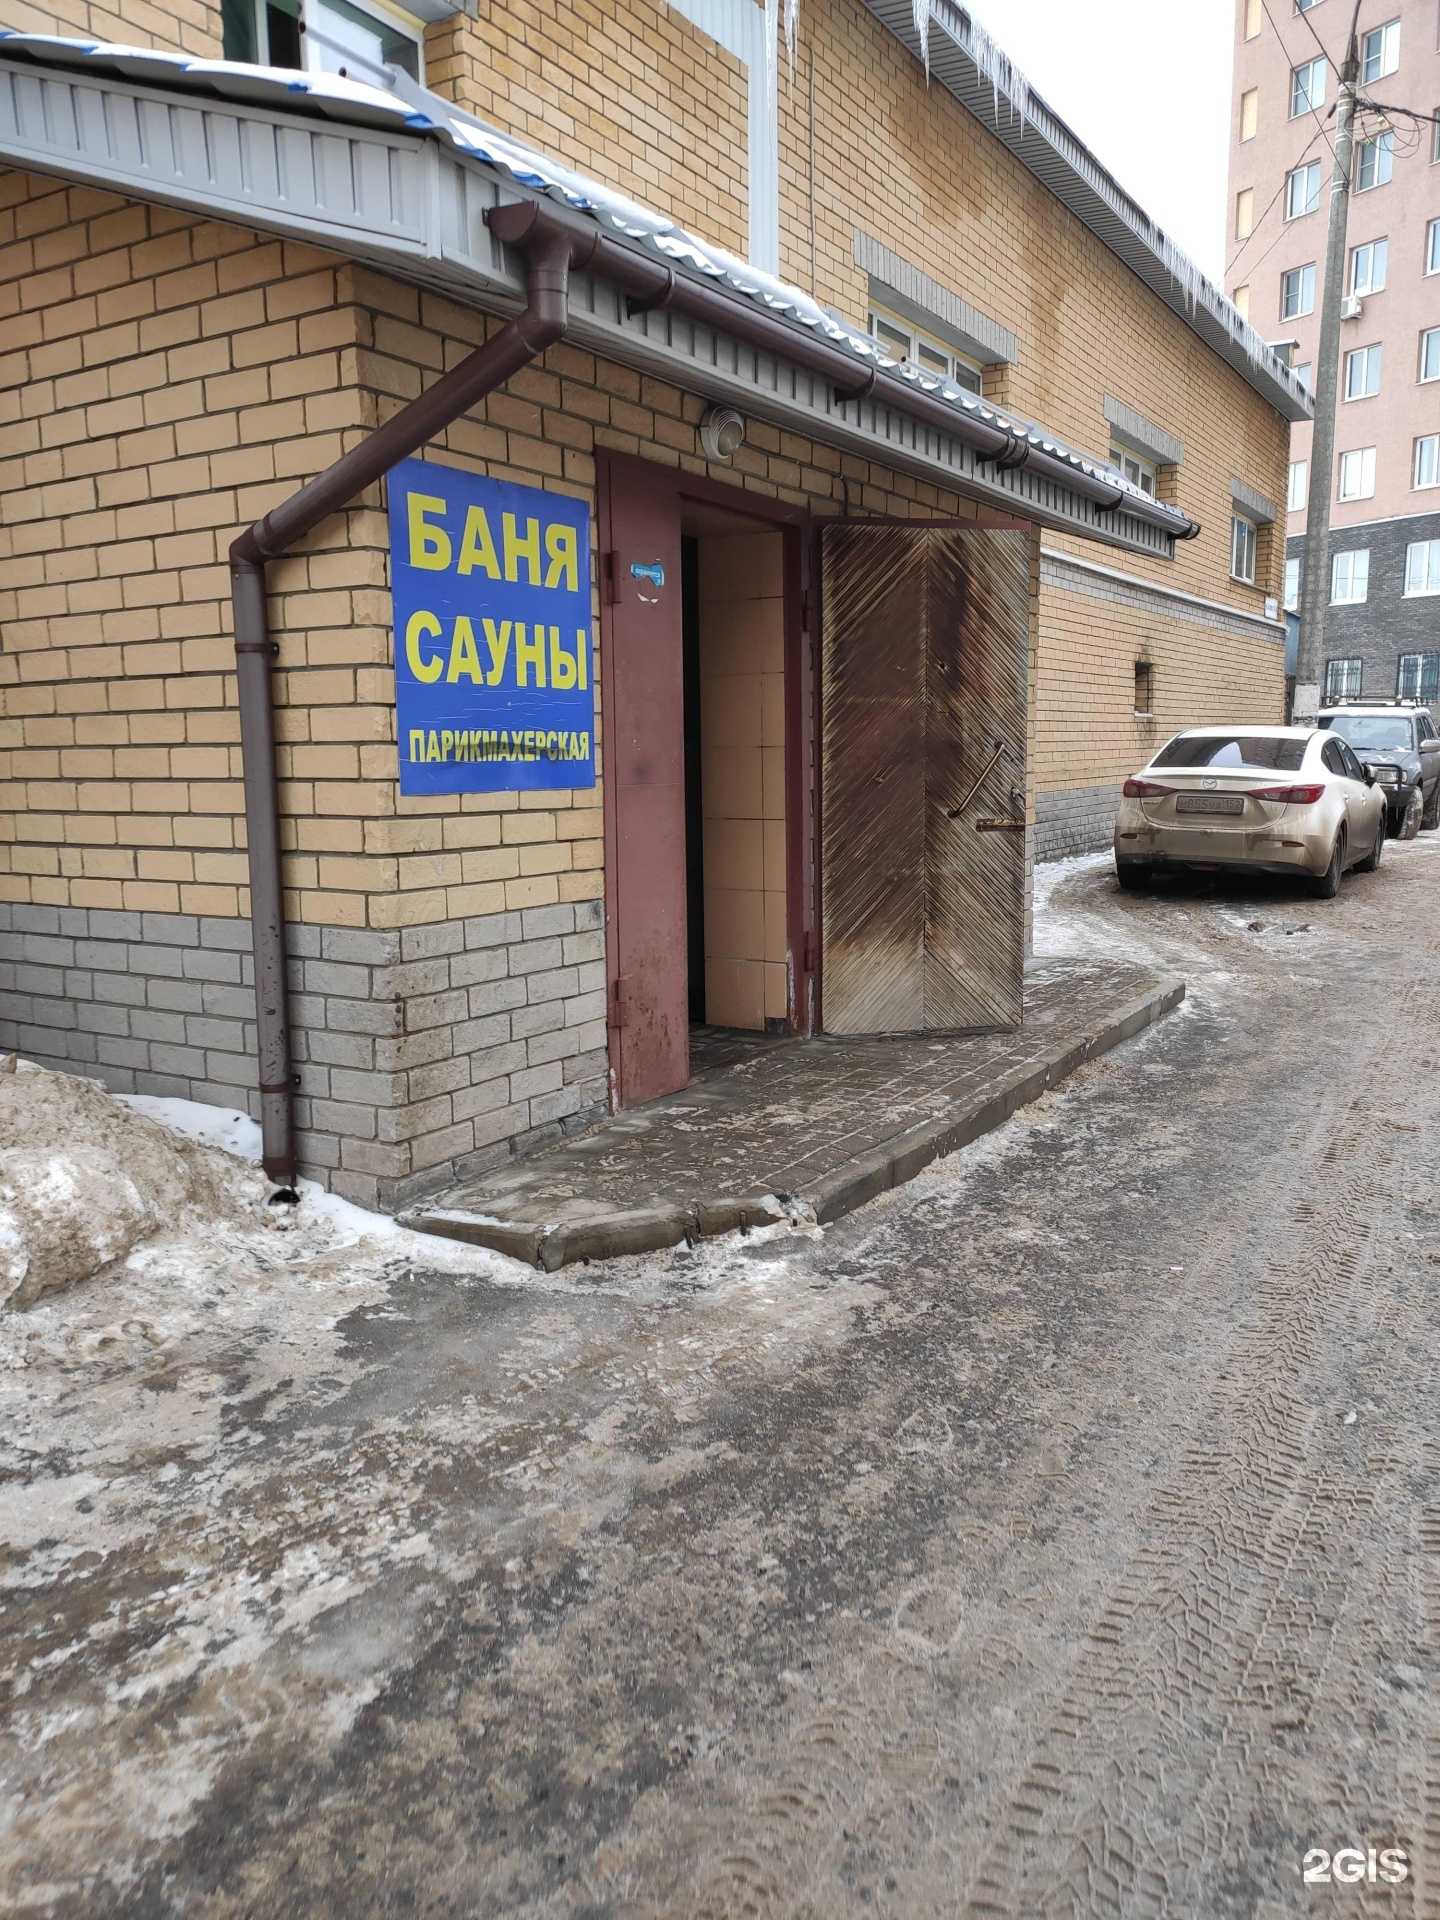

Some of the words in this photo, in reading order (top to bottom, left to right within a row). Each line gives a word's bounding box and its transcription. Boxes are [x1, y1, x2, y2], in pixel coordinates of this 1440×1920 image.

[407, 491, 579, 592] БАНЯ
[405, 610, 588, 691] САУНЫ
[409, 730, 590, 763] ПАРИКМАХЕРСКАЯ
